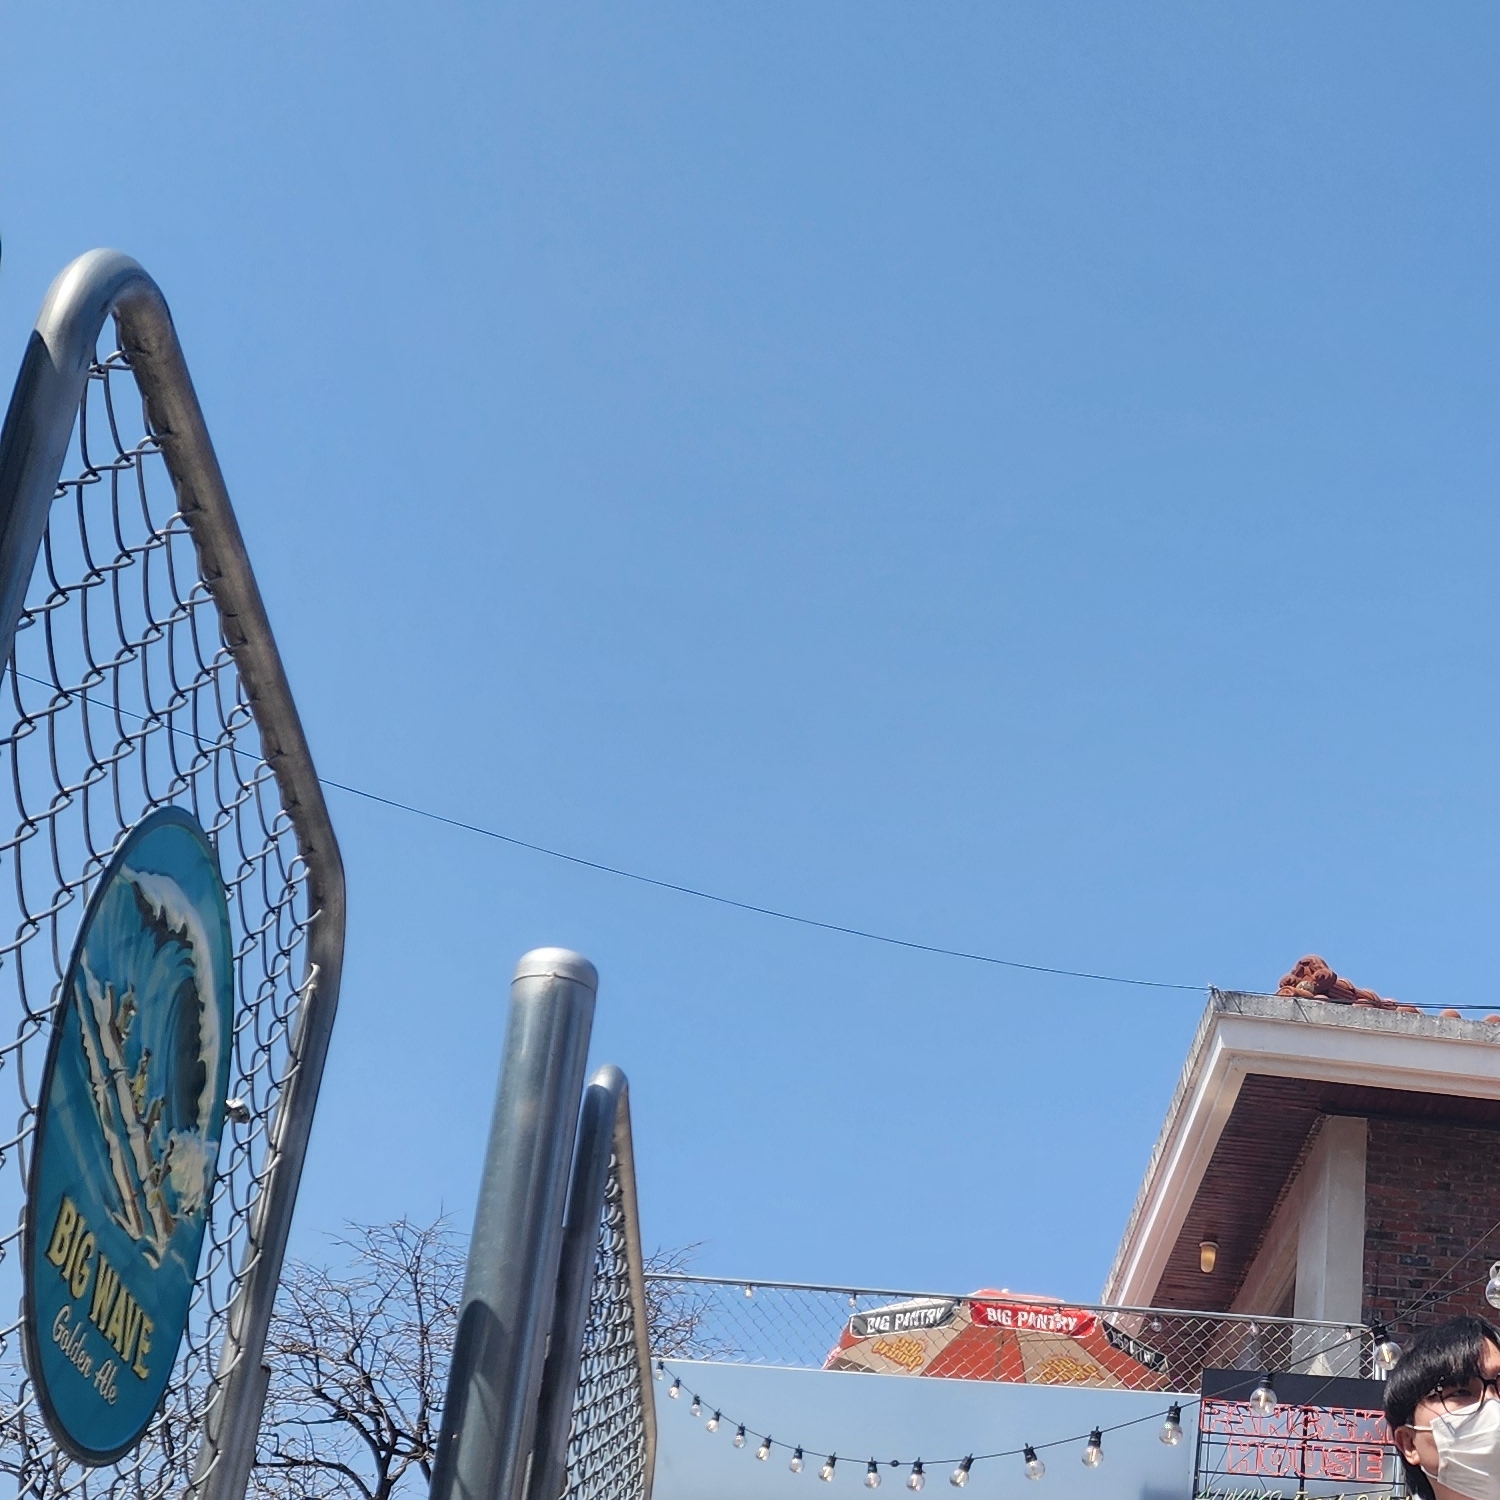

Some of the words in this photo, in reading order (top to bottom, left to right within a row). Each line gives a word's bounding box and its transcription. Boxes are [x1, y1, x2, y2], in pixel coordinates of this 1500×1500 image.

[46, 1194, 96, 1299] BIG
[88, 1250, 154, 1380] WAVE
[866, 1313, 890, 1334] BIG
[894, 1306, 945, 1330] PANTRY
[986, 1306, 1012, 1327] BIG
[1017, 1310, 1078, 1331] PANTRY
[52, 1304, 93, 1378] Golden
[93, 1358, 119, 1405] Ale
[1200, 1396, 1396, 1445] PANCAK
[1227, 1438, 1385, 1483] HOUSE
